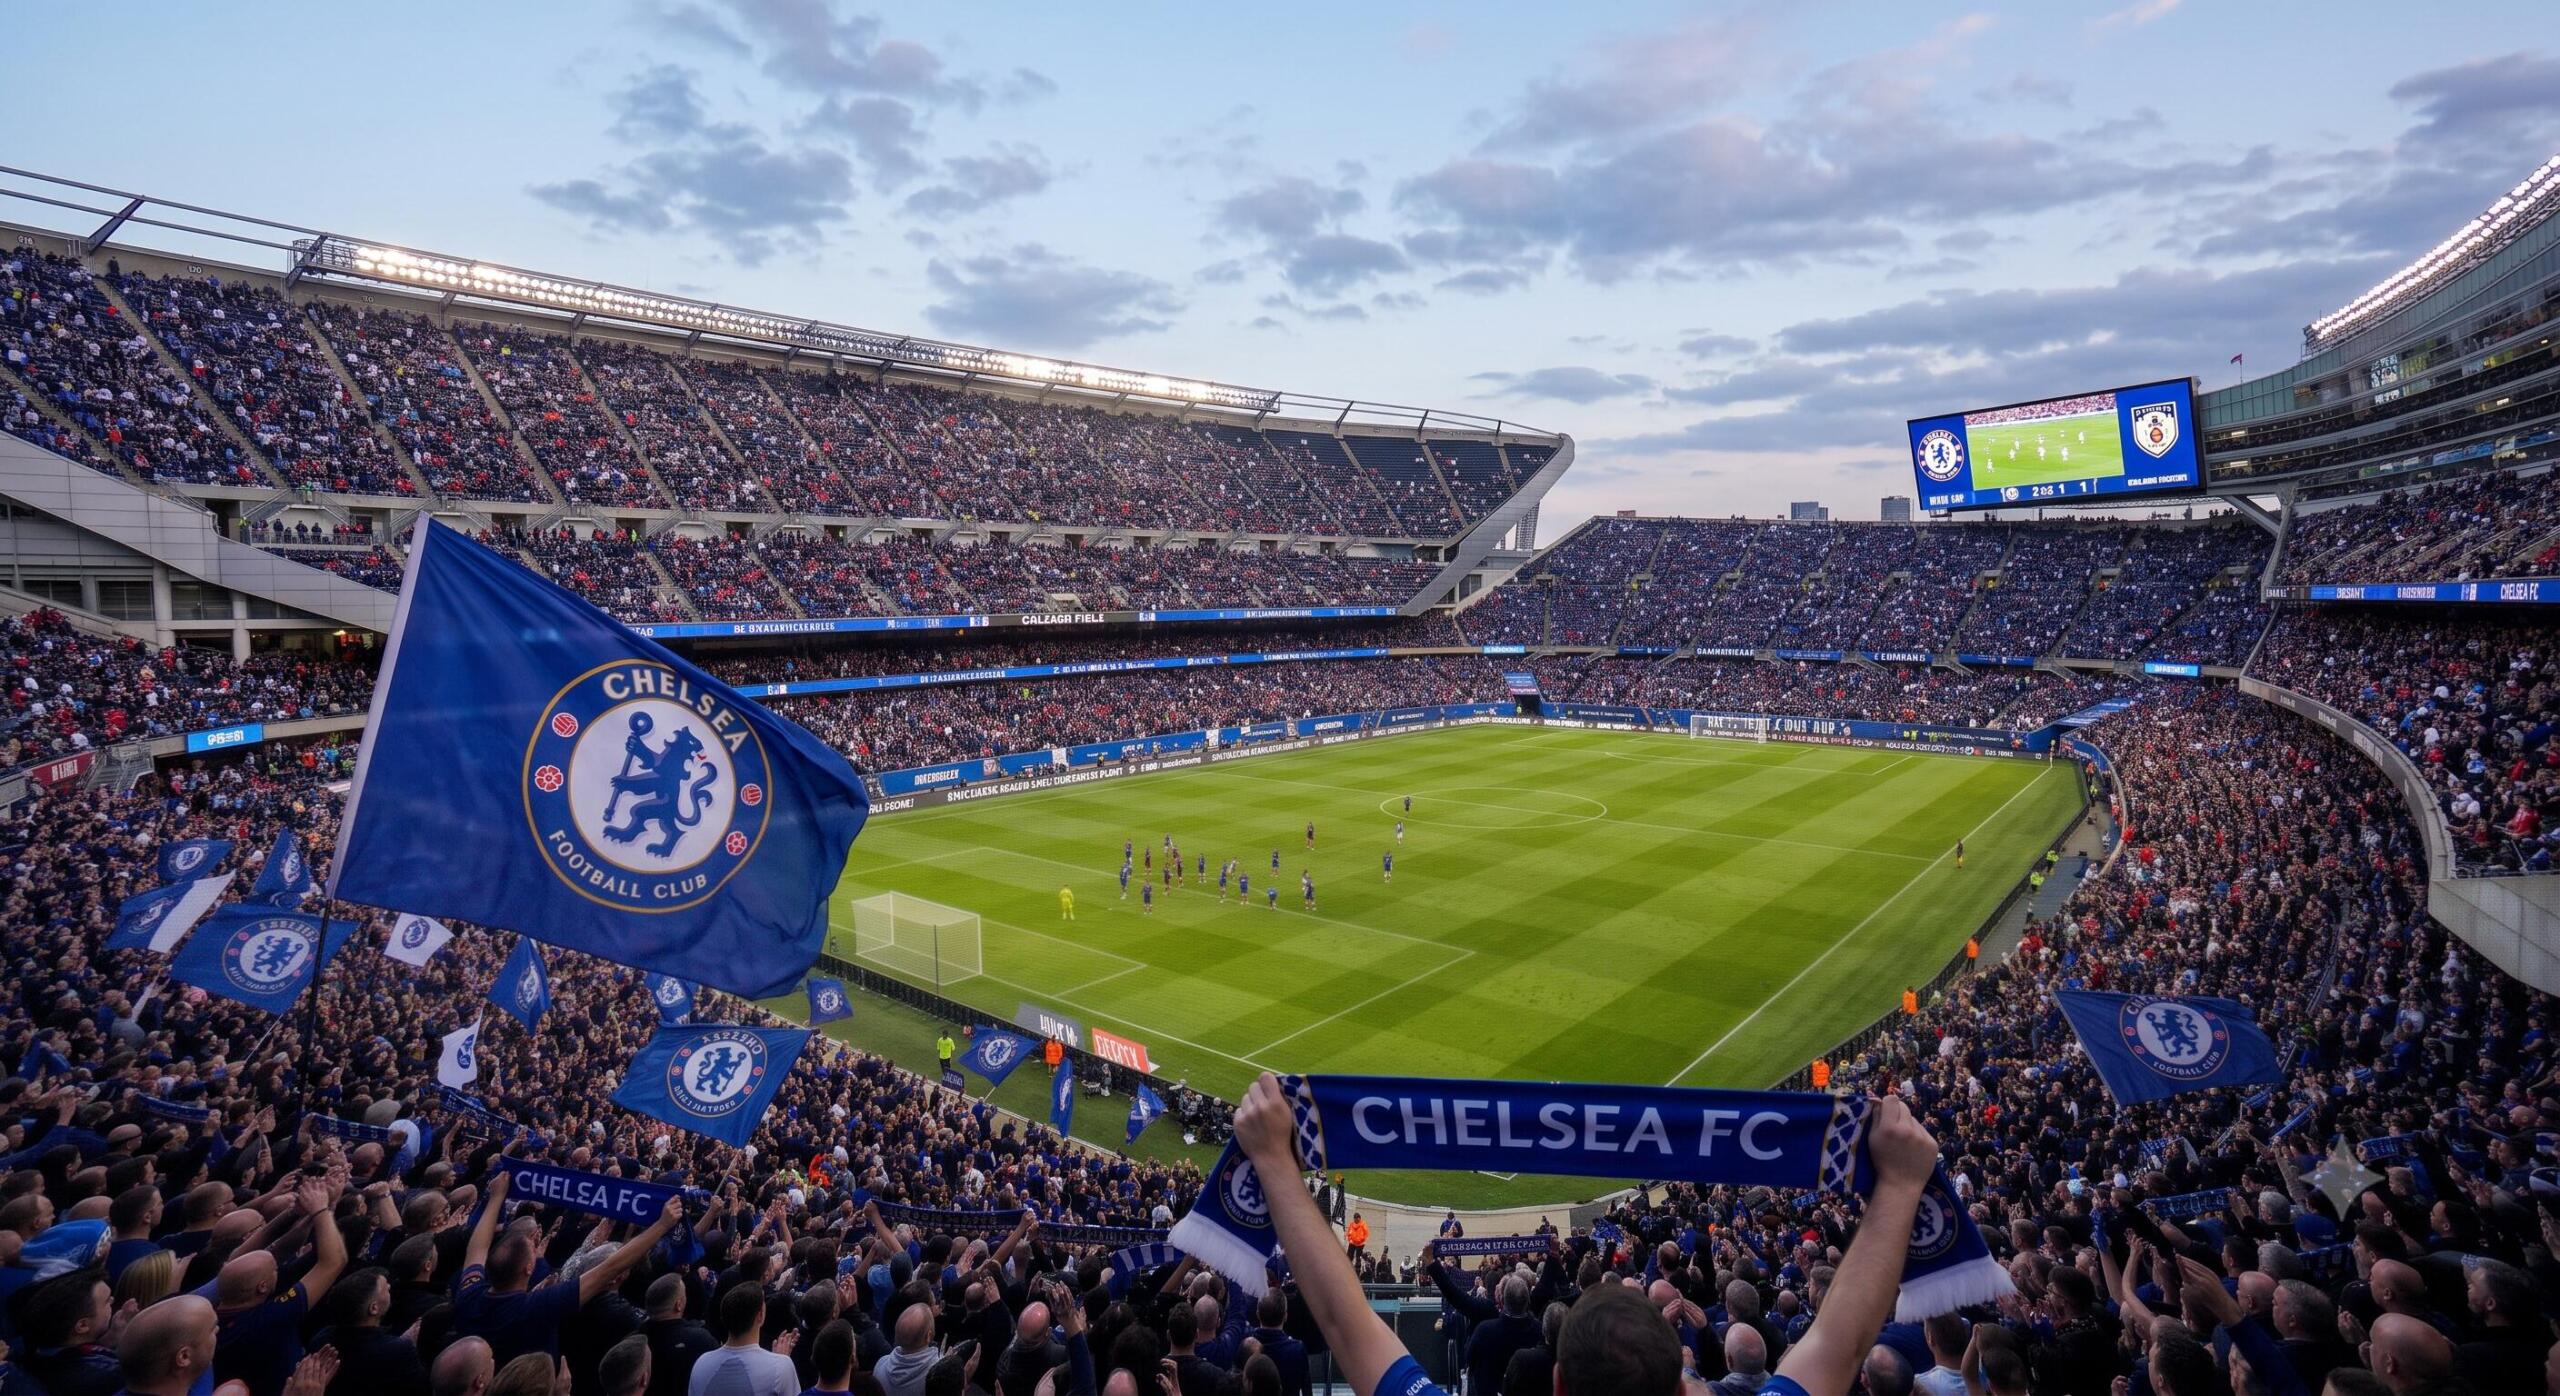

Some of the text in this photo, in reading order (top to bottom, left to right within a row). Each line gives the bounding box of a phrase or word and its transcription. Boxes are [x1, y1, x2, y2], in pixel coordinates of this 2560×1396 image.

[2501, 582, 2539, 600] CHELSEA FC
[603, 668, 751, 755] CHELSEA
[549, 829, 708, 899] FOOTBALL CLUB
[1352, 1096, 1790, 1161] CHELSEA FC
[616, 1188, 651, 1216] FC
